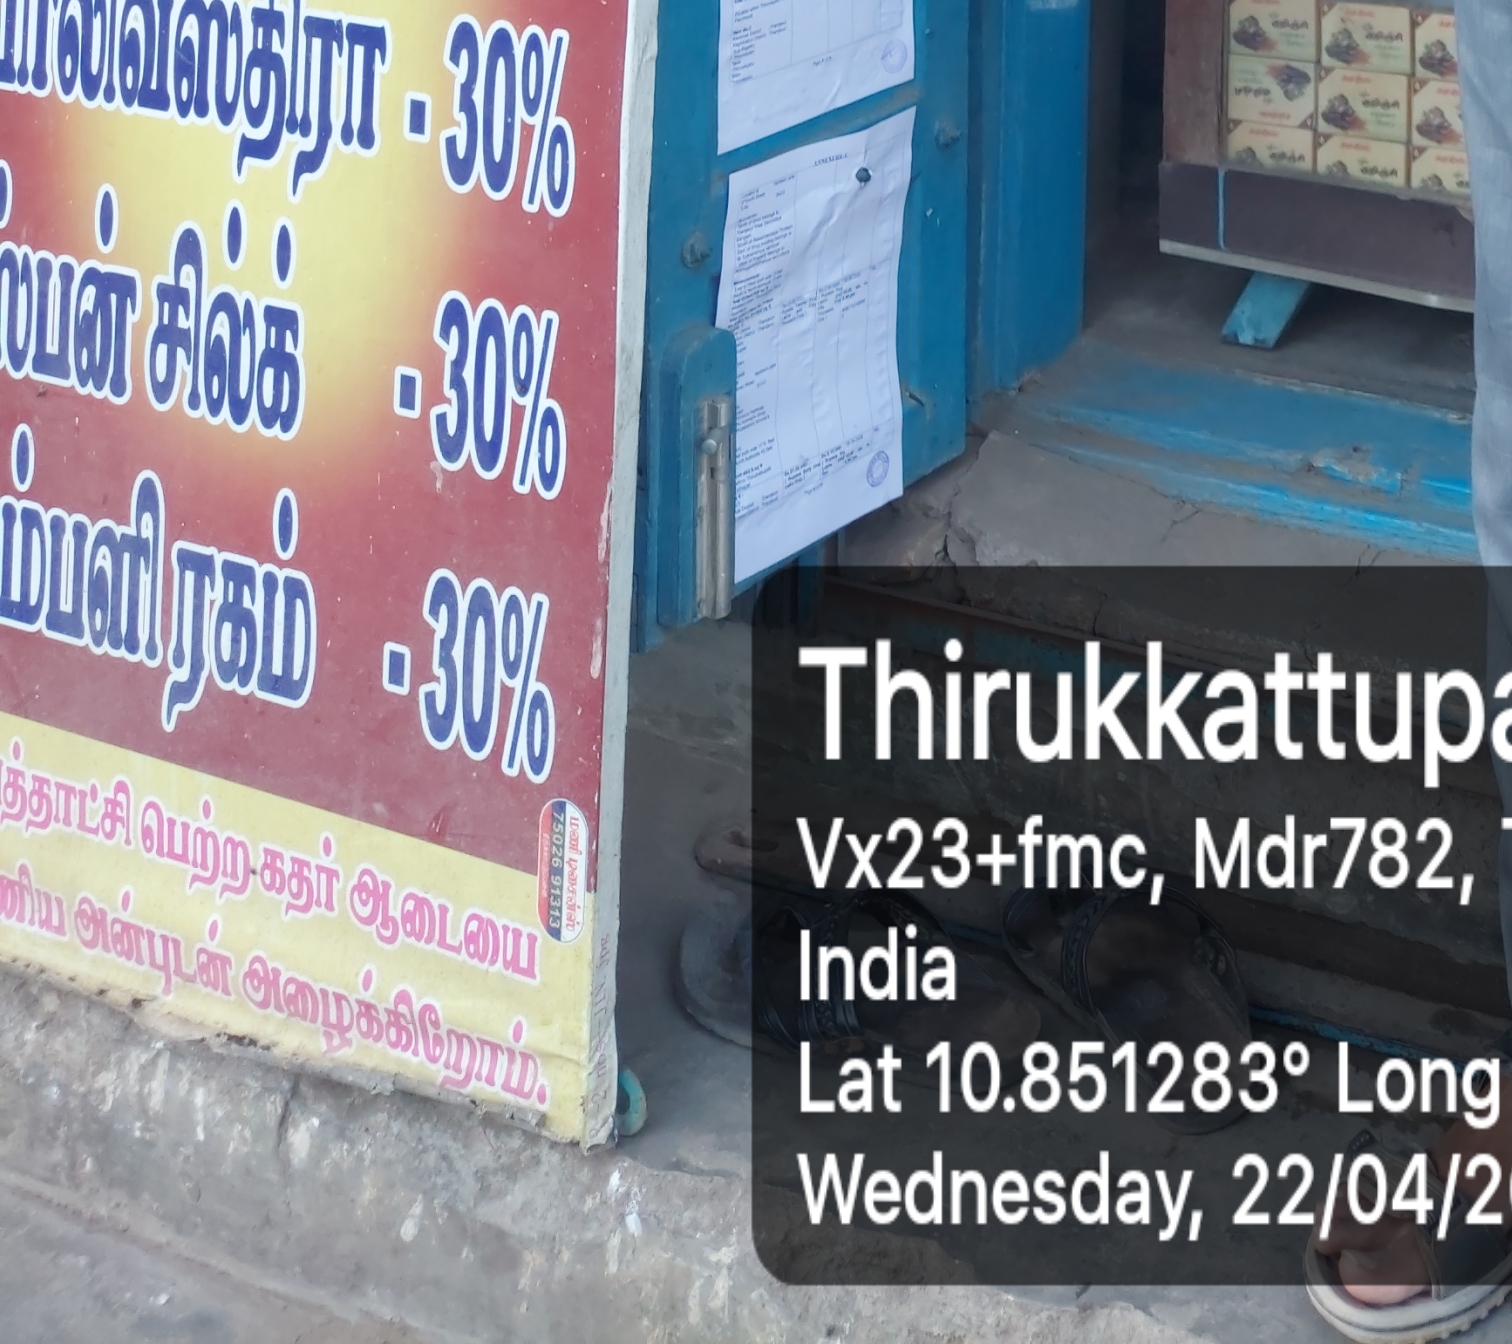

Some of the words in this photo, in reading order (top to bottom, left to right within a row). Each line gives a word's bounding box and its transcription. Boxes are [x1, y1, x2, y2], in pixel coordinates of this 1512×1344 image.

[149, 206, 301, 434] சில்க்
[0, 431, 160, 661] ம்பளி
[166, 495, 311, 726] ரகம்
[0, 741, 131, 846] த்தாட்சி
[140, 799, 251, 899] பெற்ற
[260, 836, 340, 917] கதர்
[349, 869, 539, 979] ஆடையை
[549, 875, 562, 929] 91313
[551, 812, 564, 868] 75026
[74, 890, 232, 996] அன்புடன்
[242, 969, 548, 1105] அழைக்கிறோம்.
